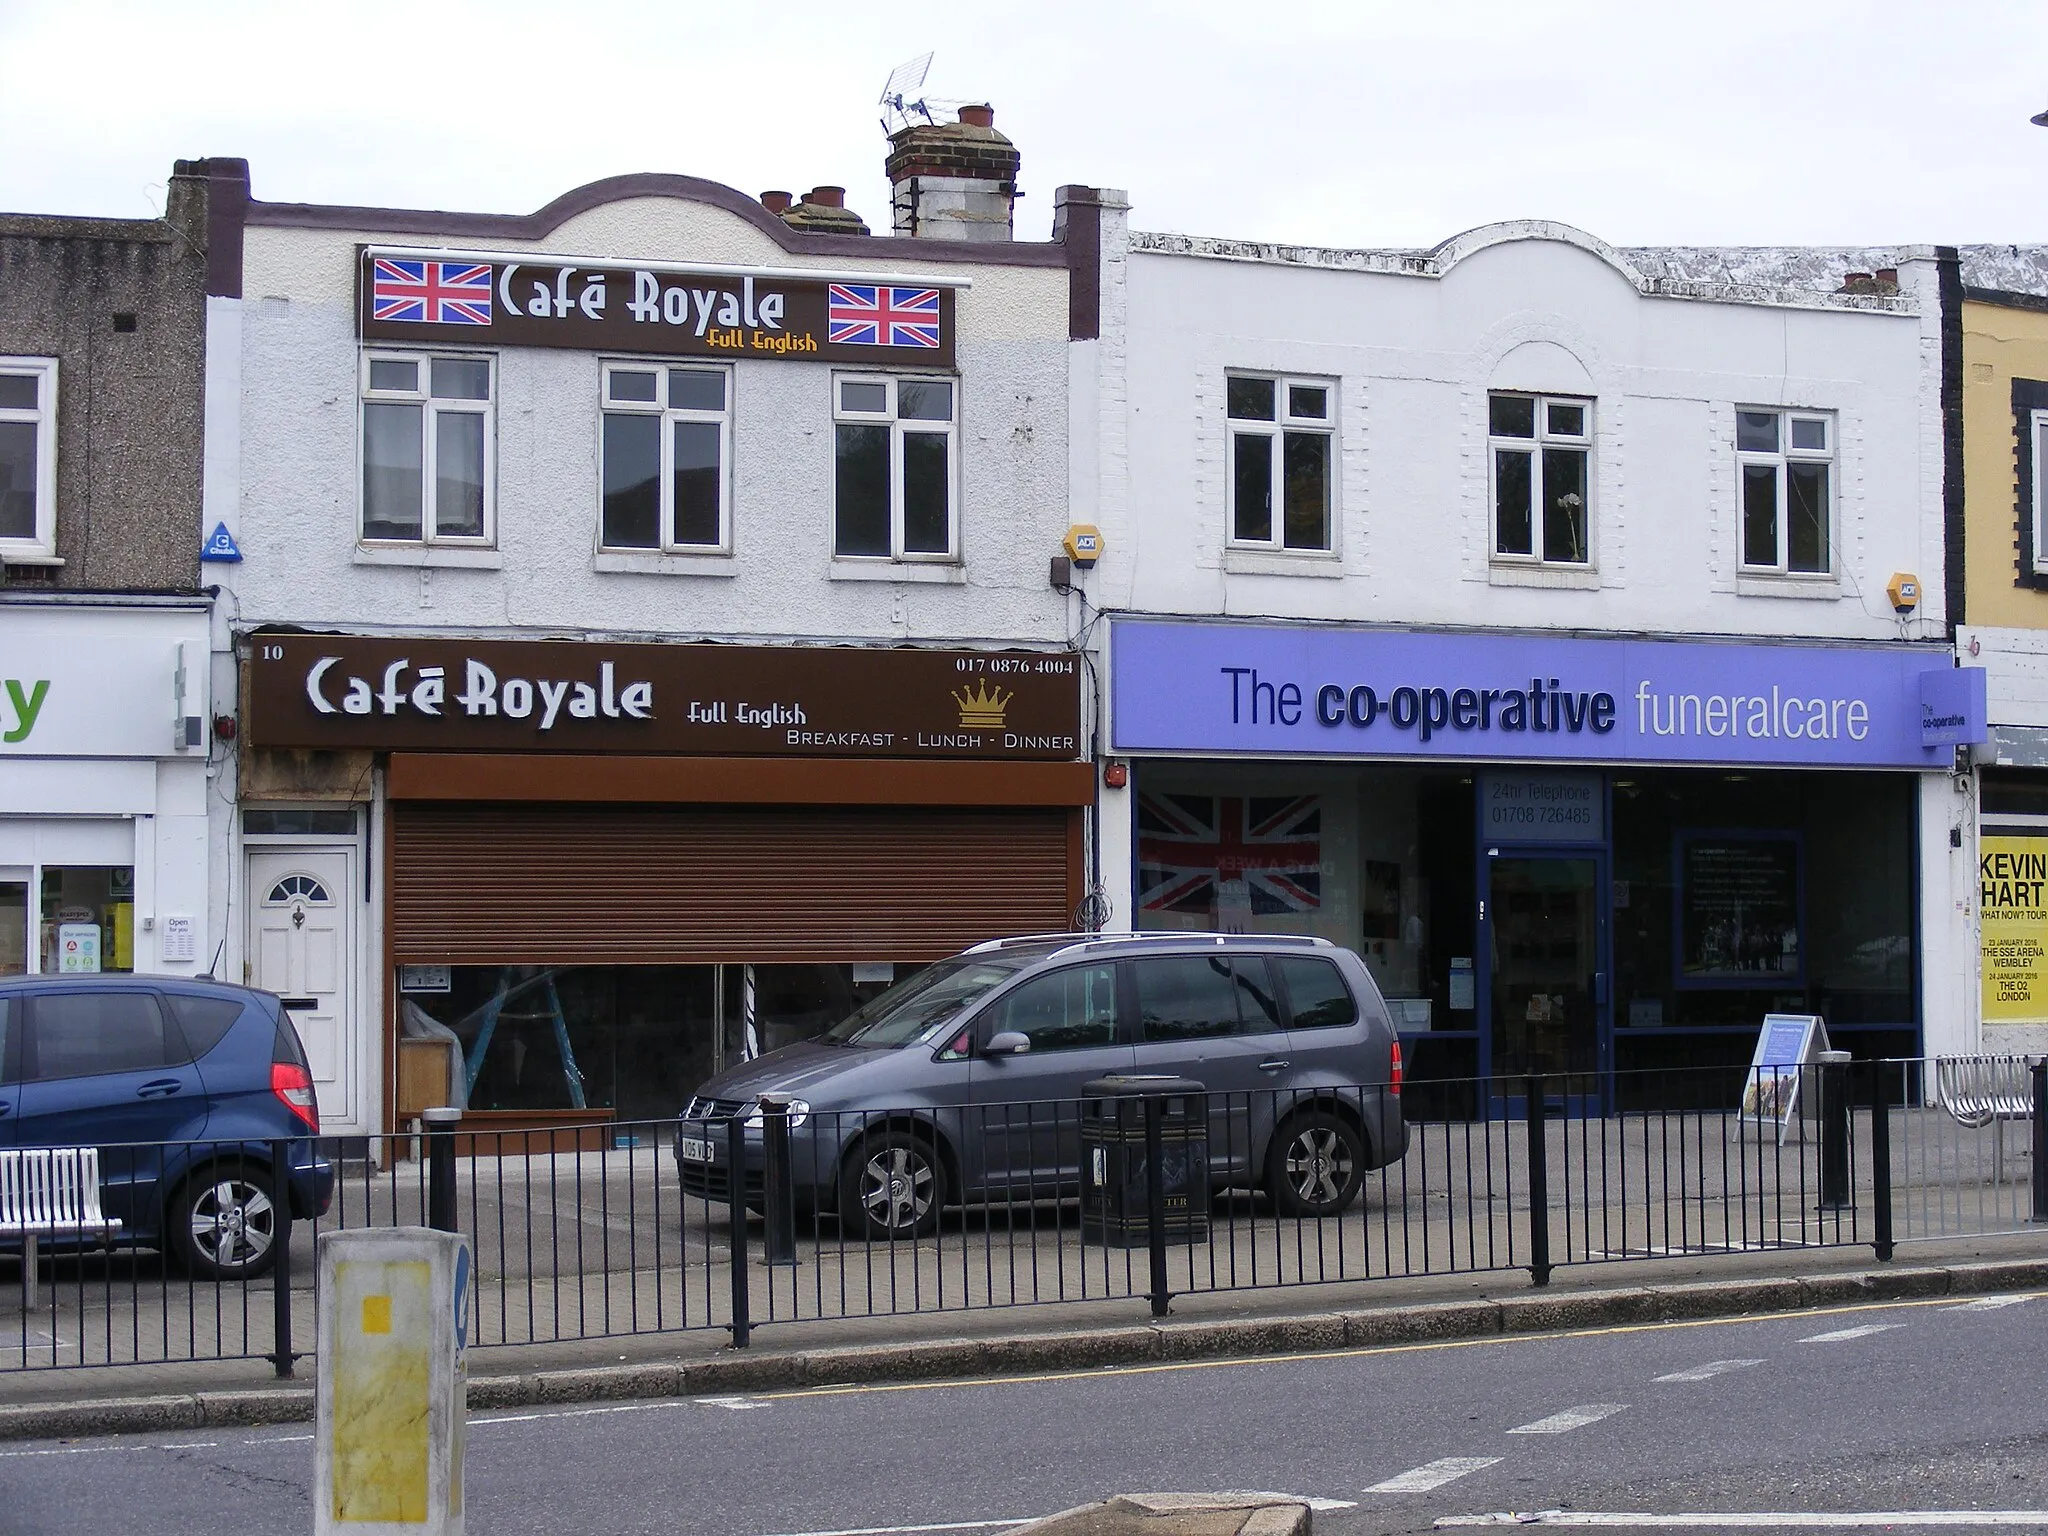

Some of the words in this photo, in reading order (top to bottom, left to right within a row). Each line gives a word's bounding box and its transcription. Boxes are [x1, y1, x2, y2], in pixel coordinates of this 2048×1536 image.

[626, 270, 785, 337] Royale
[706, 328, 744, 349] Full
[751, 331, 817, 354] English
[1077, 536, 1095, 548] ADT
[1901, 585, 1915, 595] ADT
[262, 645, 284, 660] 10
[955, 657, 985, 673] 017
[991, 658, 1029, 674] 0876
[1034, 659, 1073, 675] 4004
[456, 658, 656, 731] Royale
[0, 679, 51, 743] y
[1220, 667, 1302, 726] The
[1316, 677, 1616, 743] co-operative
[1635, 680, 1869, 741] funeralcare
[1922, 703, 1933, 716] The
[687, 701, 727, 724] Full
[735, 702, 806, 729] English
[1922, 714, 1965, 730] co-operative
[1492, 783, 1522, 799] 24hr
[1528, 783, 1591, 802] Telephone
[1492, 806, 1534, 823] 01708
[1540, 807, 1591, 824] 726485
[1980, 853, 2046, 879] KEVIN
[1982, 881, 2044, 907] HART
[169, 918, 188, 926] Open
[2002, 910, 2024, 919] NOW?
[2026, 910, 2047, 920] TOUR
[1982, 947, 1998, 957] THE
[1999, 947, 2015, 957] SSE
[2017, 947, 2044, 957] ARENA
[1993, 958, 2033, 967] WEMBLEY
[1999, 981, 2015, 990] THE
[1996, 992, 2031, 1001] LONDON
